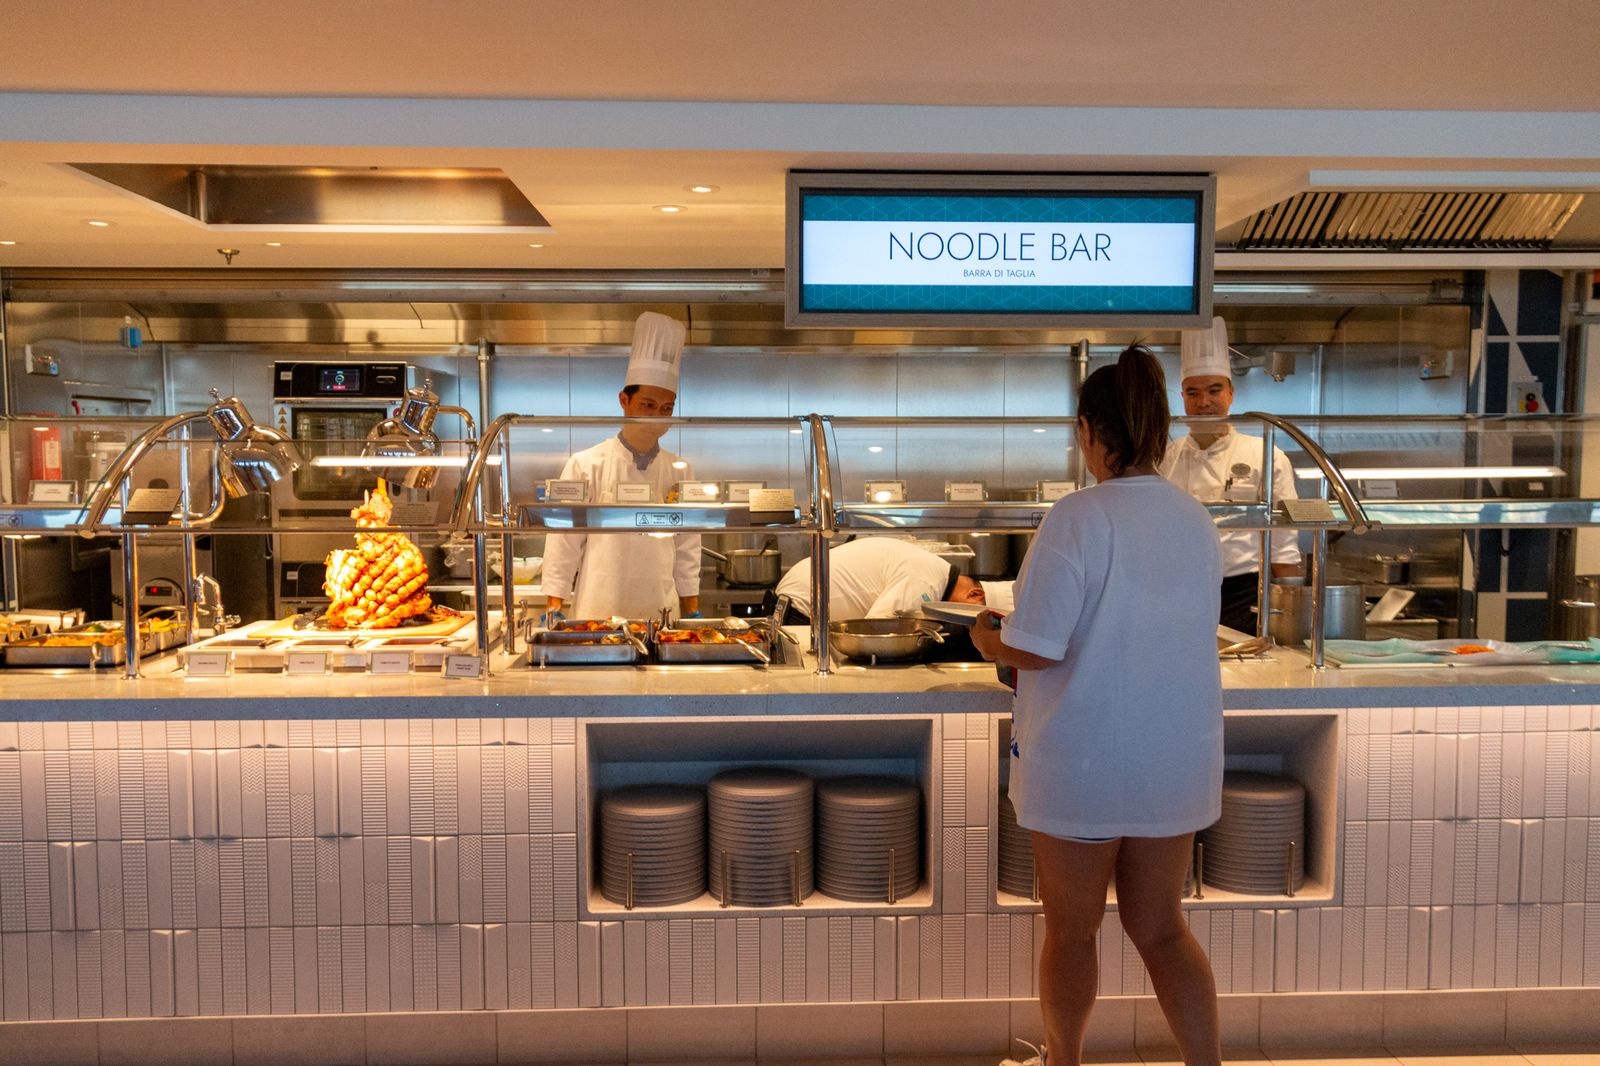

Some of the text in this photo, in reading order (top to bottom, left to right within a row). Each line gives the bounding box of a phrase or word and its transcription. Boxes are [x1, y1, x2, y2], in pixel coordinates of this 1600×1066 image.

[889, 231, 1112, 262] NOODLE BAR
[963, 269, 1036, 278] BARRA DI TAGLIA
